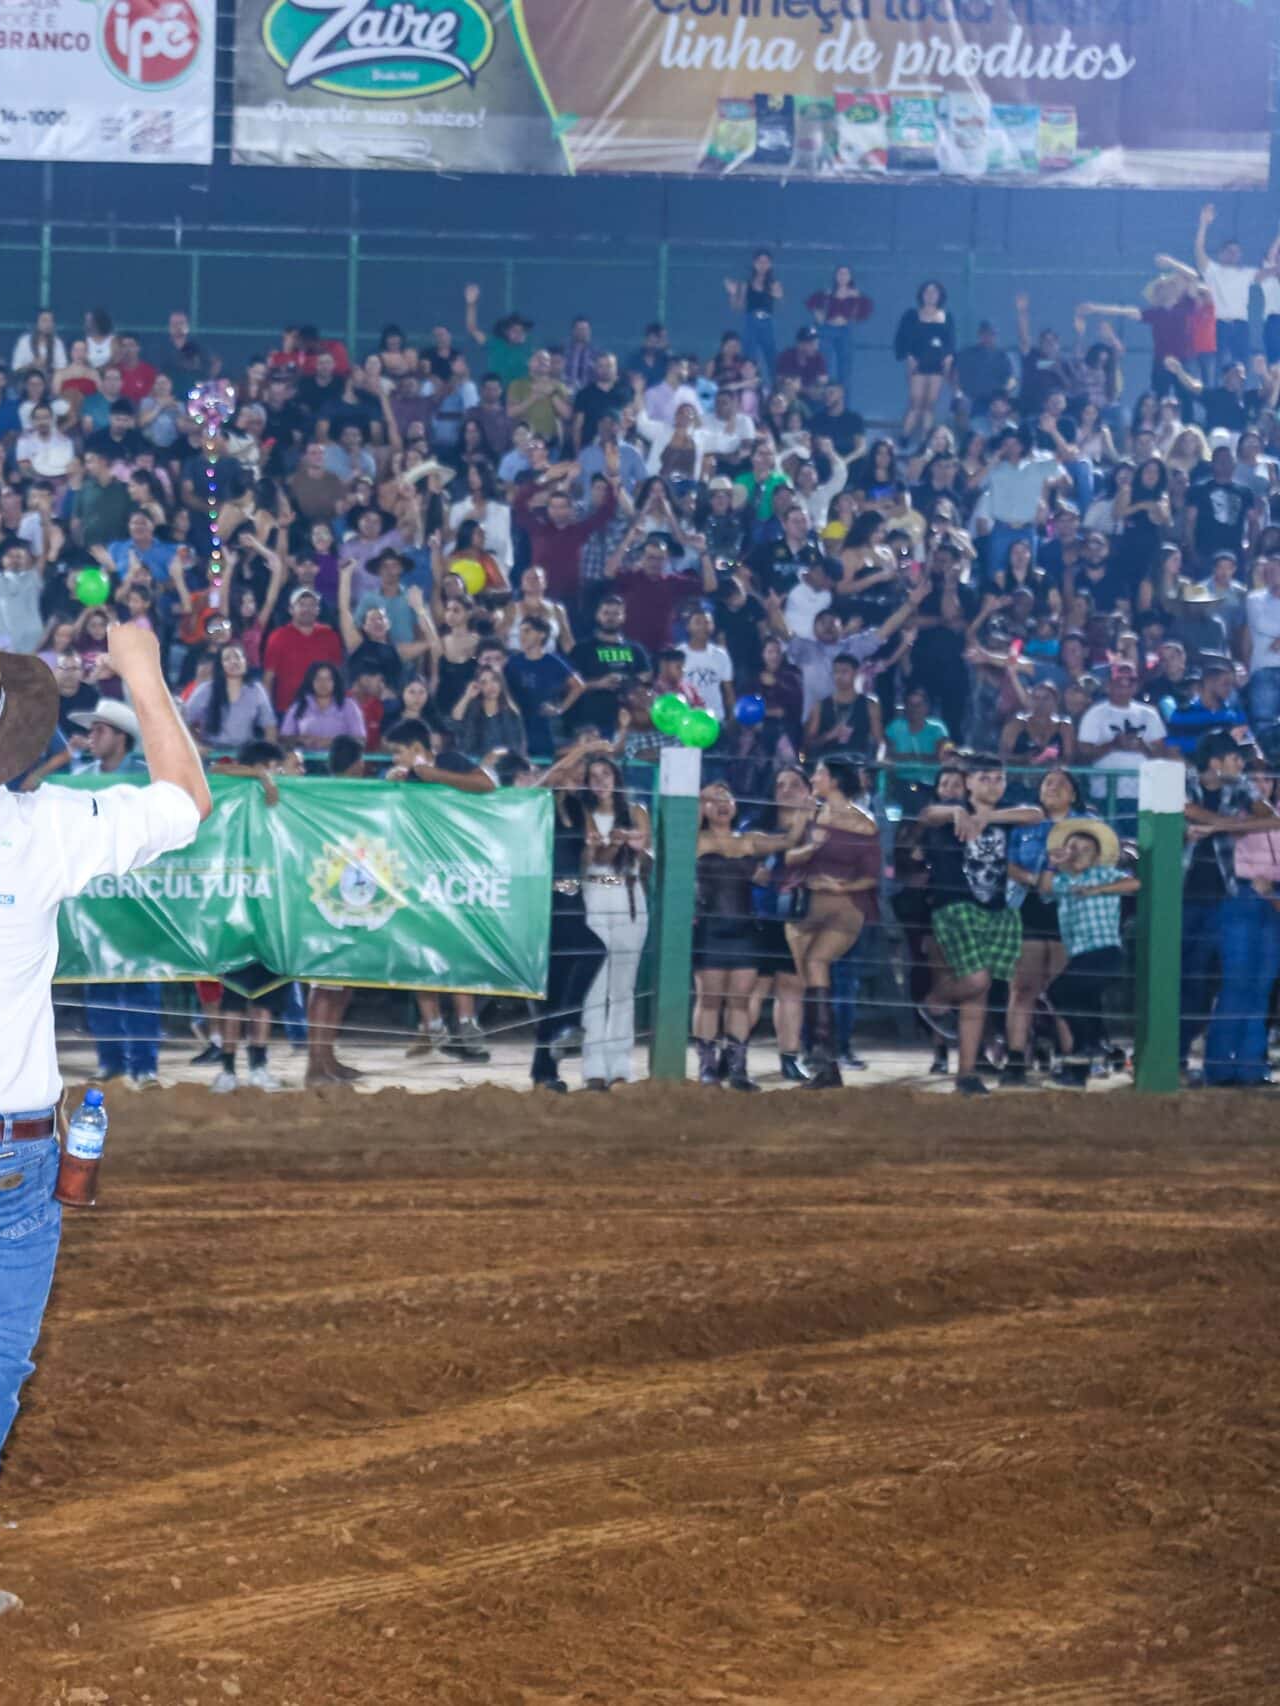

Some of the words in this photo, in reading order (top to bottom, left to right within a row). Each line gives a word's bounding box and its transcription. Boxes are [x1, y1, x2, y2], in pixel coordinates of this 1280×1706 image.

[115, 1, 193, 81] ipê
[286, 0, 472, 84] Zaire
[660, 14, 803, 71] linha
[814, 19, 882, 74] de
[886, 24, 1136, 93] produtos
[78, 873, 272, 899] AGRICULTURA
[421, 873, 511, 908] ACRE
